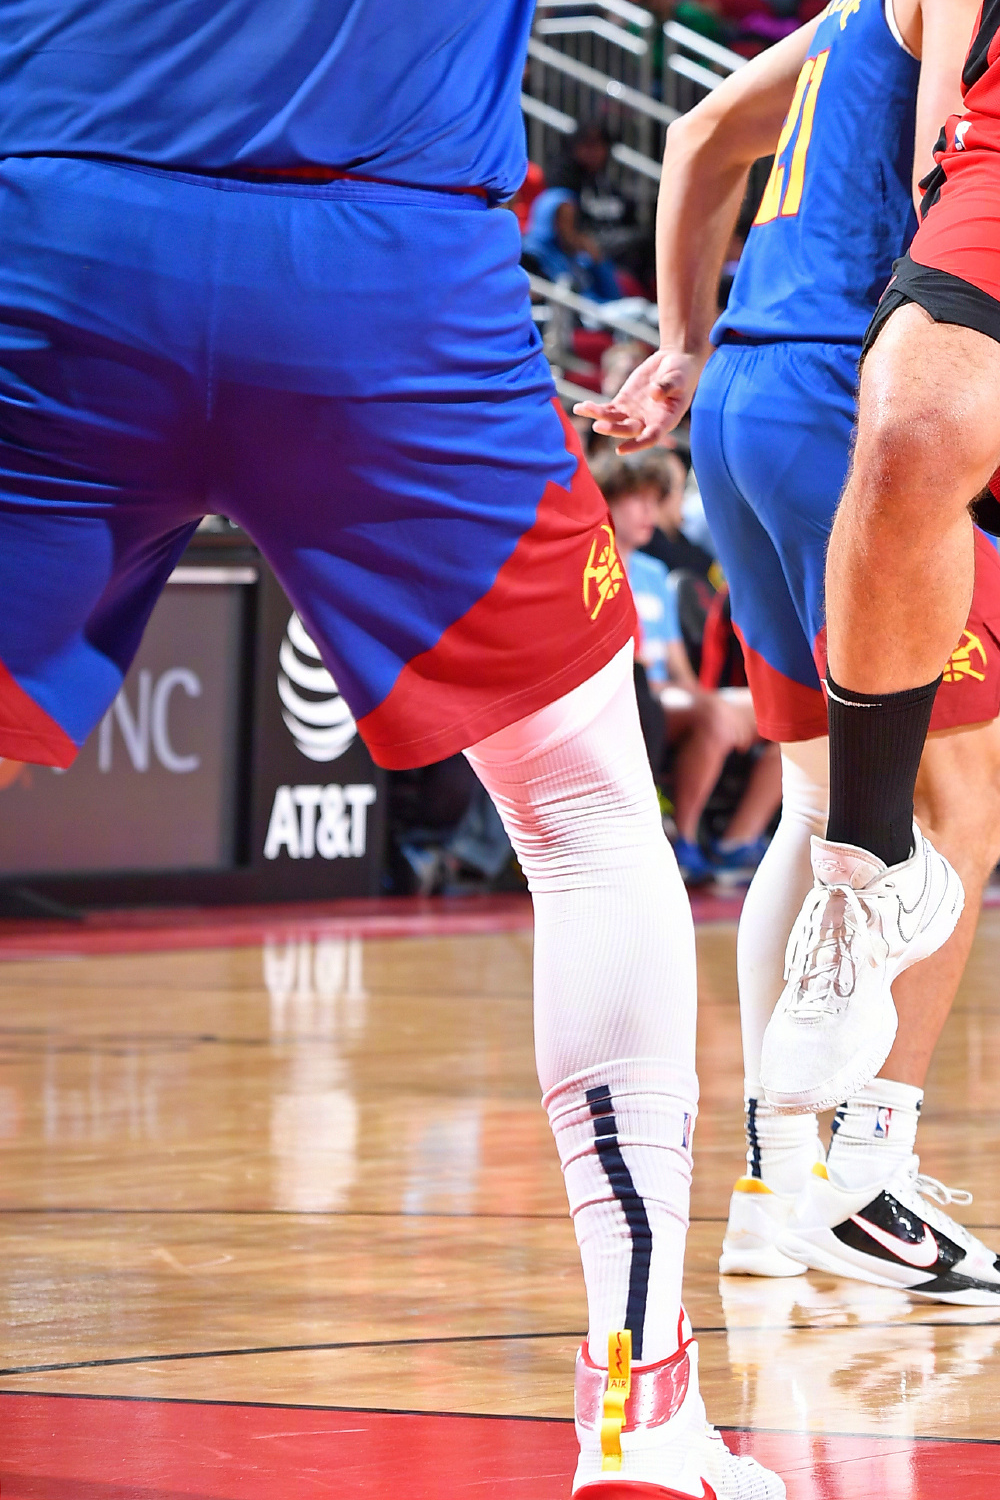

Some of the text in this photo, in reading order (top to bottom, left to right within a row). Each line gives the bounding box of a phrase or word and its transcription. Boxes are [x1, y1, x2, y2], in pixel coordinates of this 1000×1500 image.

[97, 667, 201, 774] NC
[263, 783, 377, 861] AT&T
[610, 1379, 627, 1389] AIR
